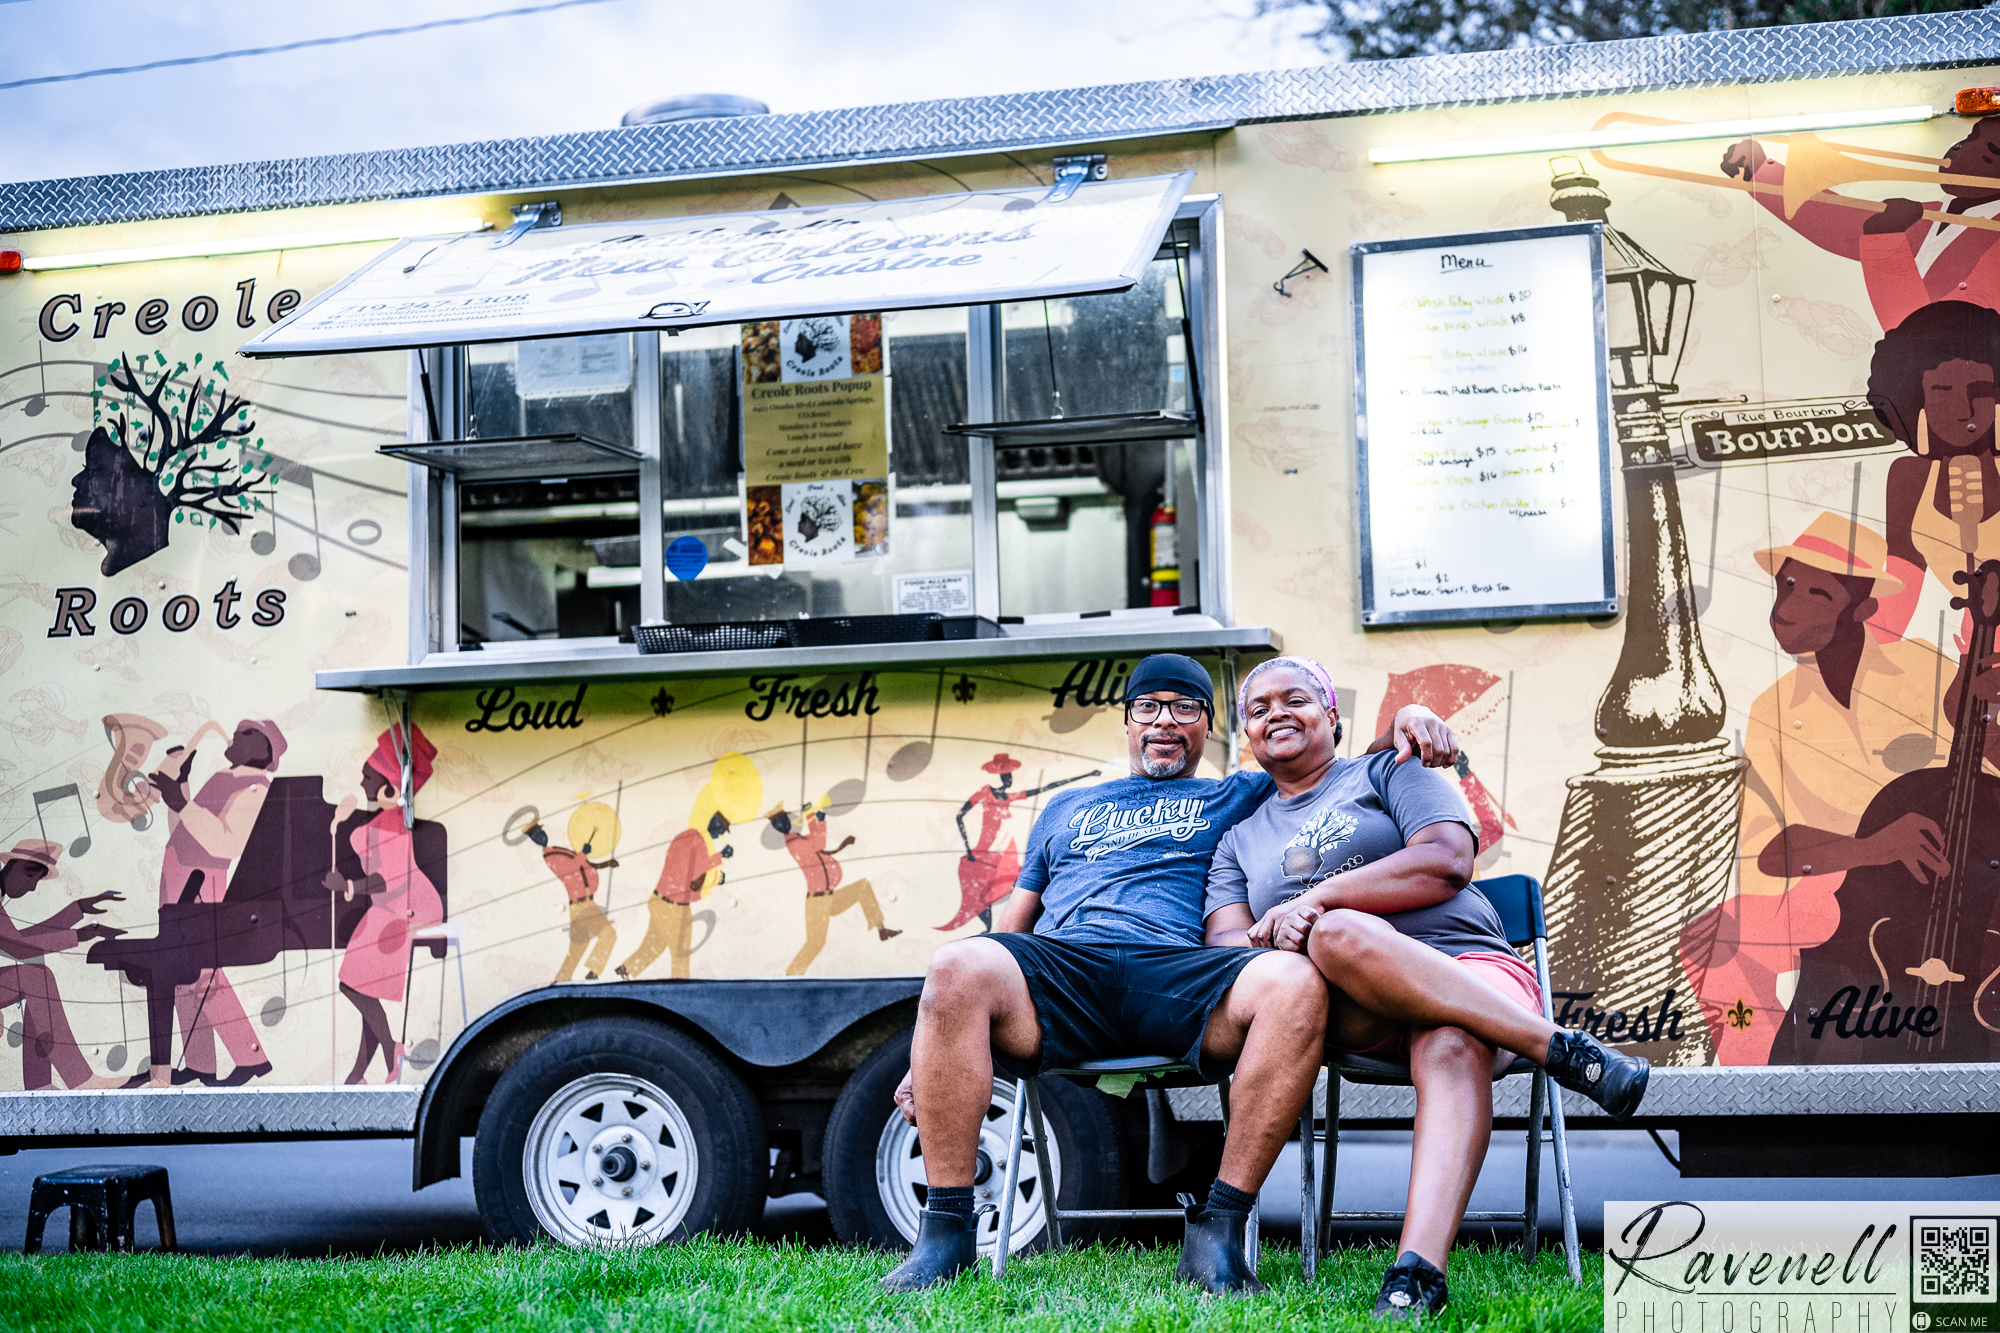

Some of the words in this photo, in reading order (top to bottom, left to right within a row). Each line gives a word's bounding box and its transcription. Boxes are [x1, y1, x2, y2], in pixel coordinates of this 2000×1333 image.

[503, 253, 688, 286] New
[710, 220, 1037, 268] Orleans
[1440, 254, 1493, 270] Menu
[749, 252, 983, 285] Cuisine
[38, 278, 302, 342] Creole
[340, 293, 530, 313] 719-247-1308
[751, 385, 793, 399] Creole
[794, 382, 830, 396] Roots
[832, 379, 873, 393] Popup
[1736, 410, 1767, 423] Rue
[1774, 407, 1837, 420] Bourbon
[1705, 420, 1884, 456] Bourbon
[765, 447, 789, 457] Come
[802, 444, 824, 454] down
[825, 442, 842, 452] and
[843, 441, 863, 450] have
[1475, 446, 1497, 459] $15
[765, 471, 792, 481] Creole
[794, 469, 818, 480] Roots
[830, 467, 843, 477] the
[1479, 471, 1497, 482] $16
[1435, 572, 1450, 584] $2
[47, 580, 288, 639] Roots
[465, 683, 588, 732] Loud
[744, 671, 880, 721] Fresh
[1050, 658, 1131, 708] Ali
[1068, 798, 1211, 851] Lucky
[1552, 989, 1685, 1043] Fresh
[1808, 985, 1942, 1040] Alive
